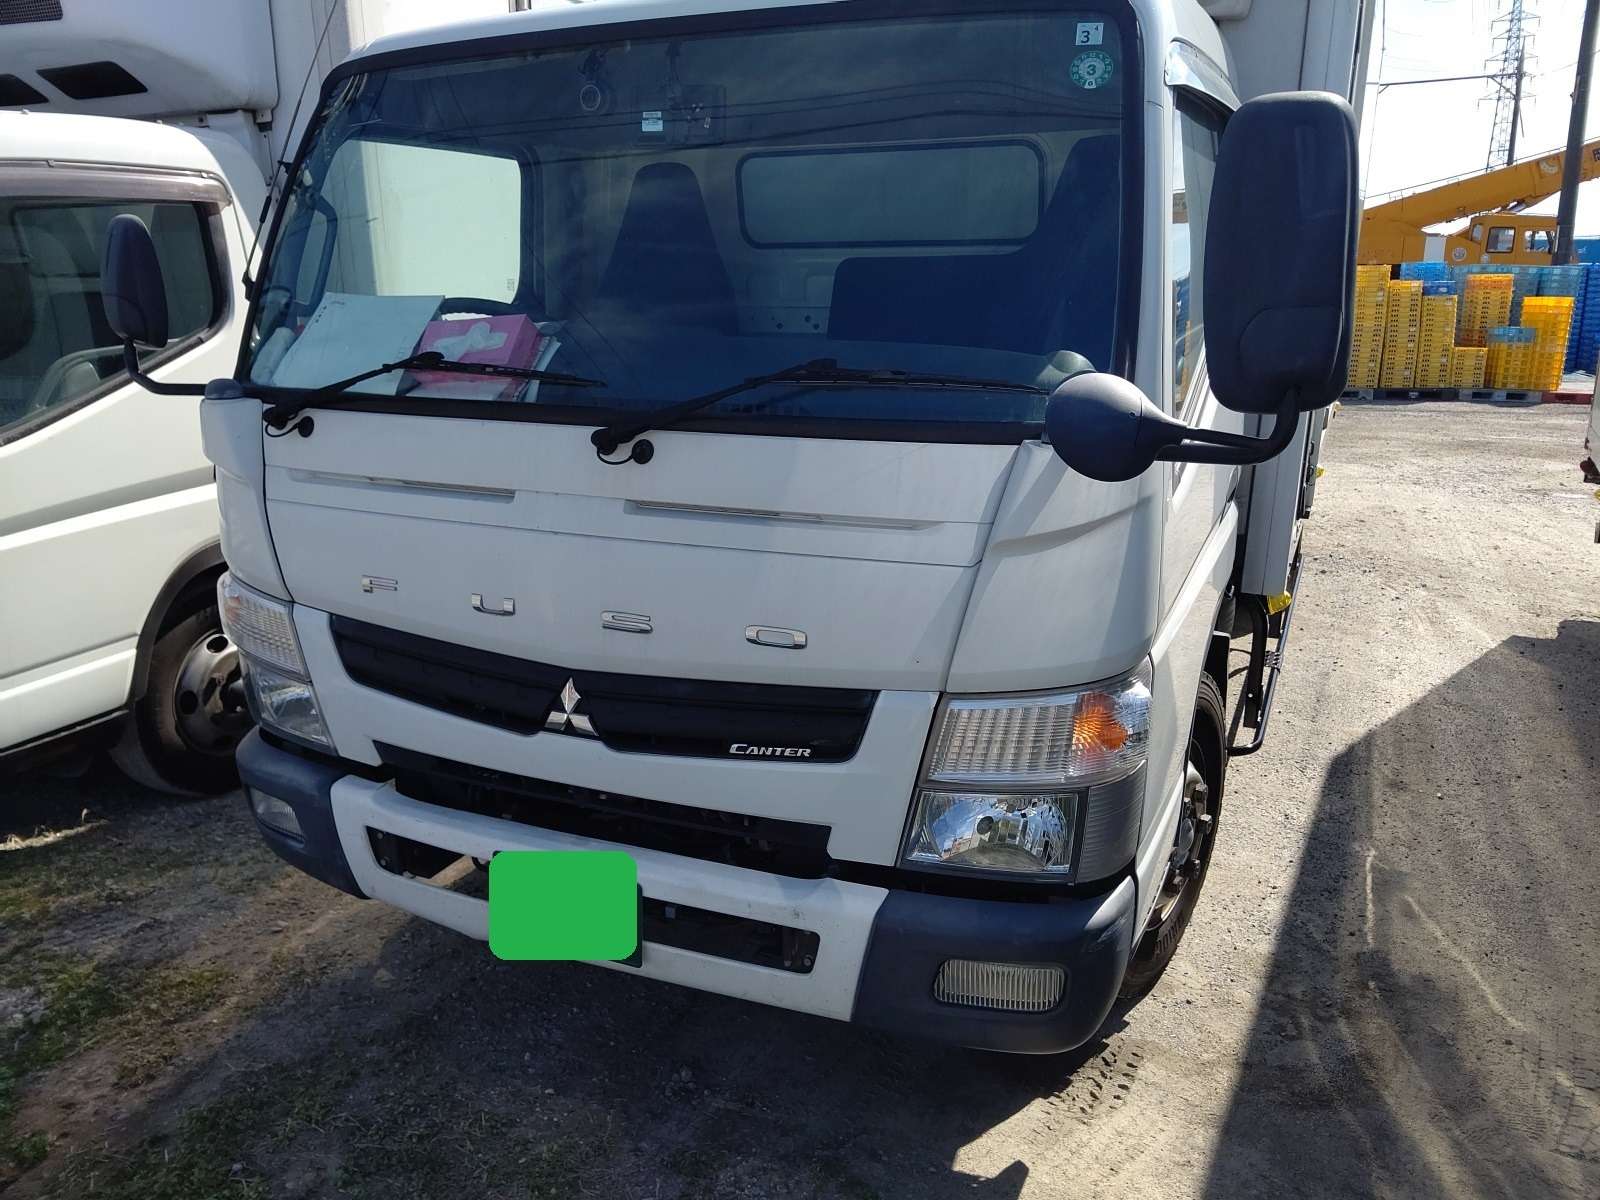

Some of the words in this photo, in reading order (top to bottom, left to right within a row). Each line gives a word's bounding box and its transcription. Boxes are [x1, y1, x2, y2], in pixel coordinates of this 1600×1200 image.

[1081, 30, 1090, 43] 3
[1087, 64, 1096, 75] 3
[362, 575, 807, 649] FUSO
[729, 743, 811, 757] CANTER
